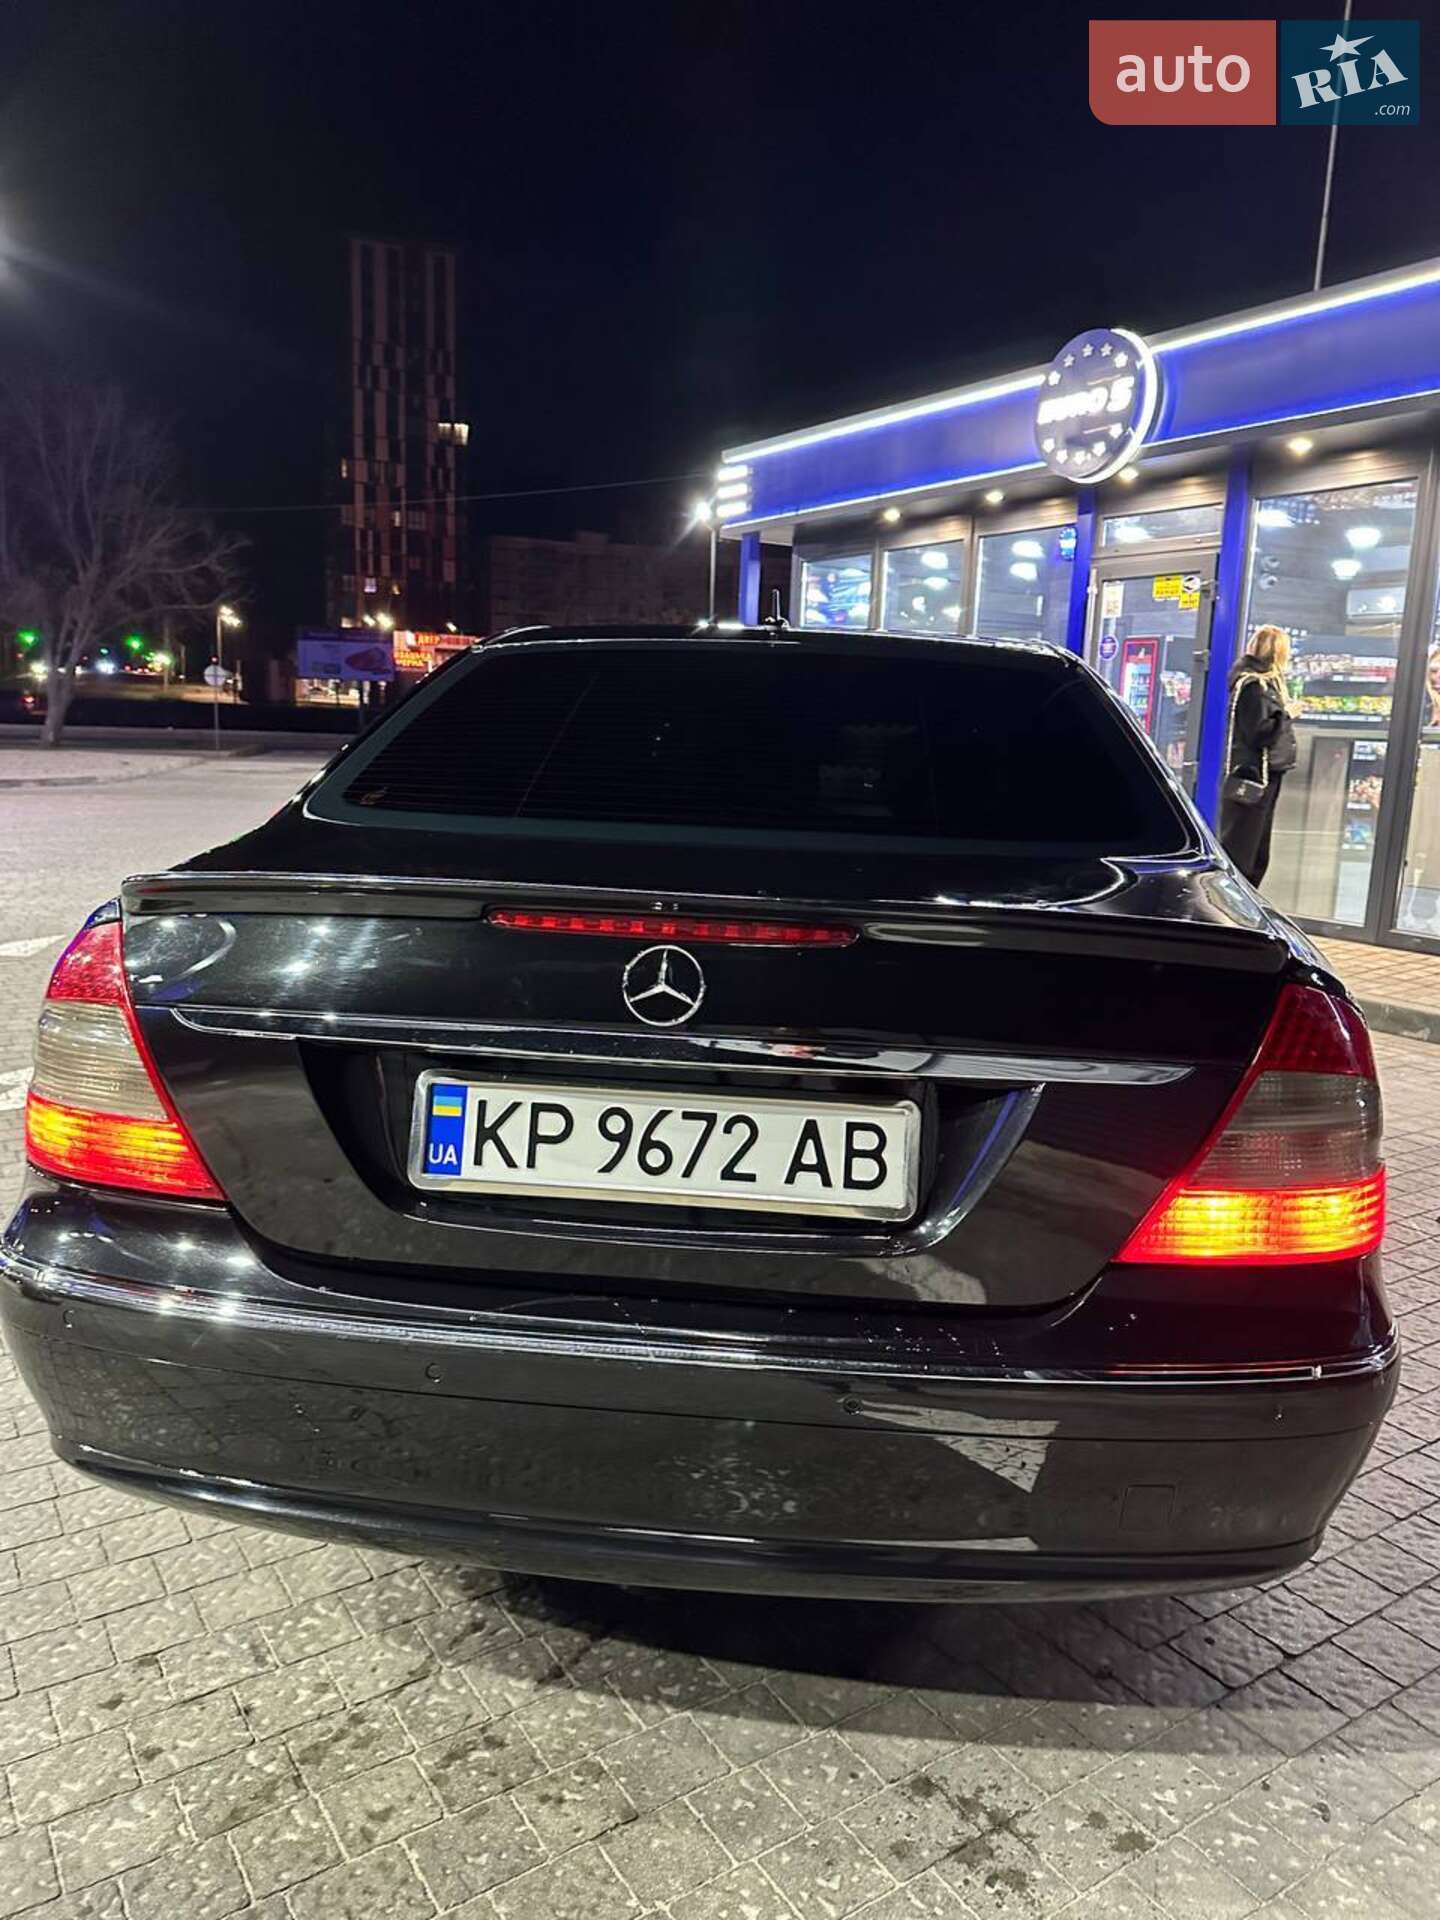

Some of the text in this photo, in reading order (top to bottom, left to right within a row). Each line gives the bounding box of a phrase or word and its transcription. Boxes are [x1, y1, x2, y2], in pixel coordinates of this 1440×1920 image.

[428, 1143, 457, 1166] UA
[473, 1099, 888, 1190] KP 9672 AB
